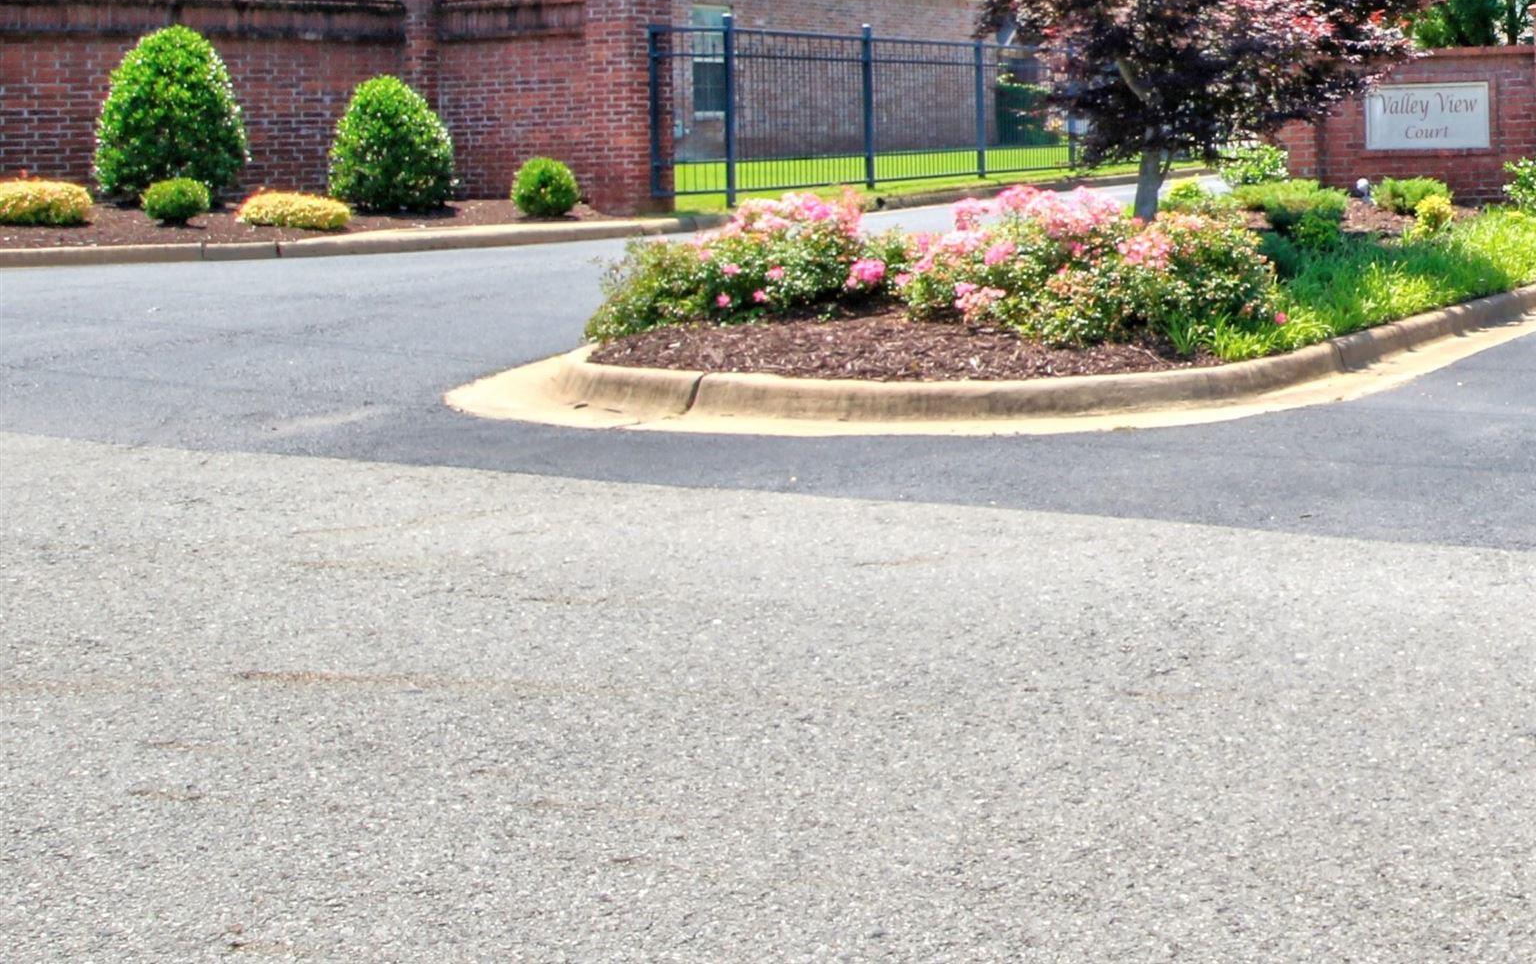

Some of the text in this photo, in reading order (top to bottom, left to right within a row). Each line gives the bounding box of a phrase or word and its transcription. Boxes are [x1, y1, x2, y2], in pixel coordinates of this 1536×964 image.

[1379, 91, 1478, 121] Valley View
[1405, 125, 1449, 140] Court
